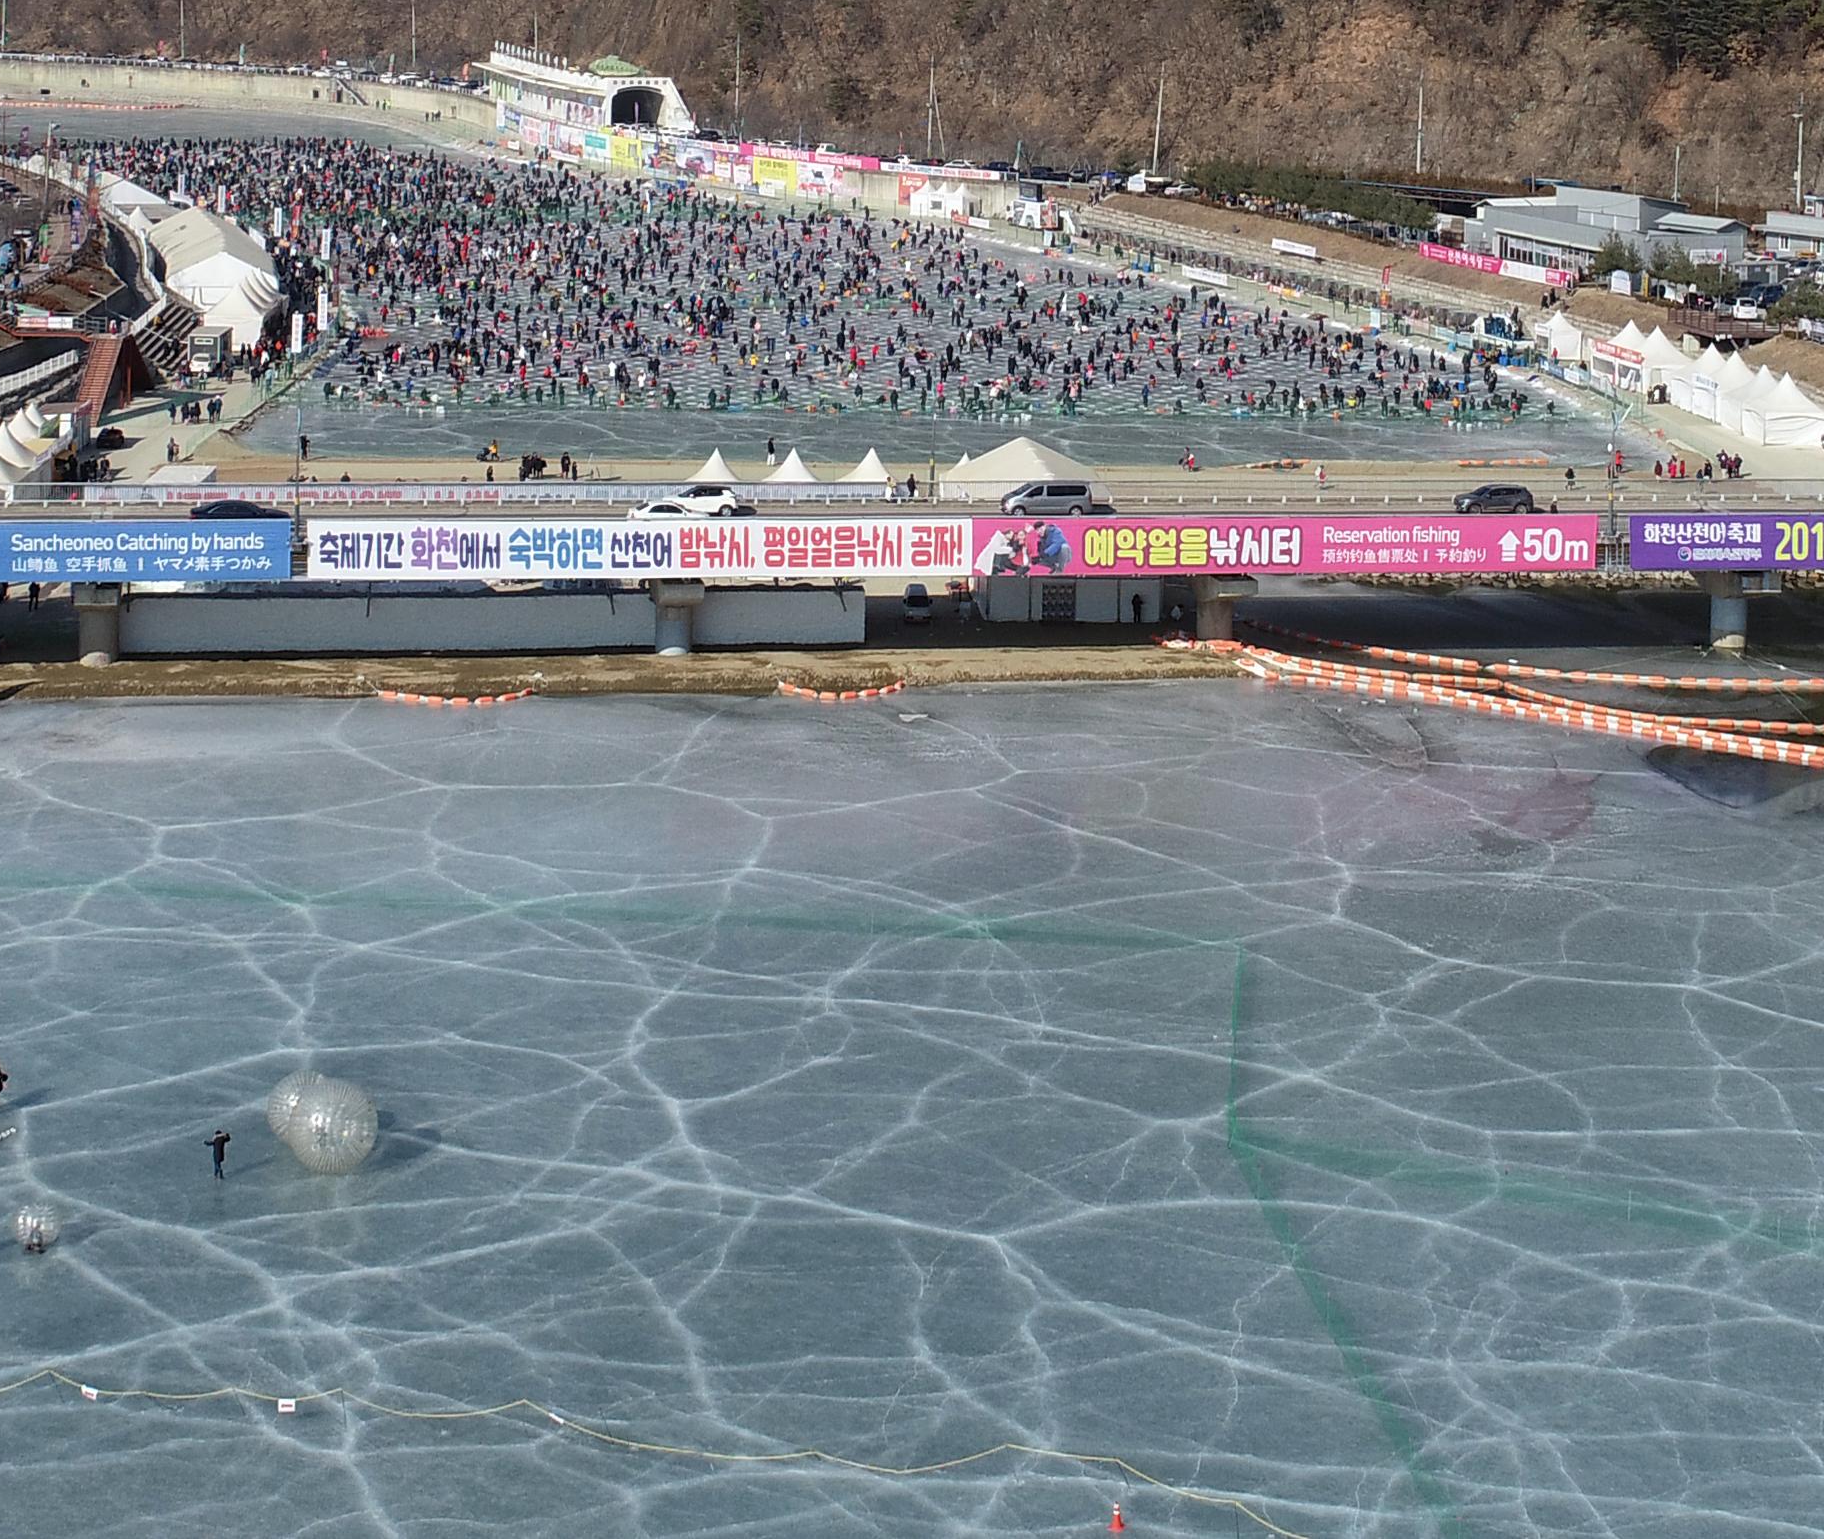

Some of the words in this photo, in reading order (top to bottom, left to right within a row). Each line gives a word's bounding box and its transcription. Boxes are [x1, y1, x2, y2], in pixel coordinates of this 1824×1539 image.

[10, 533, 114, 552] Sancheoneo
[116, 533, 188, 556] Catching
[191, 533, 211, 554] by
[213, 531, 265, 550] hands
[319, 531, 405, 569] 축제기간
[410, 526, 501, 570] 화천에서
[508, 527, 604, 570] 숙박하면
[610, 530, 672, 569] 산천어
[679, 526, 756, 569] 밤낚시,
[763, 525, 903, 568] 평일얼음낚시
[910, 524, 963, 567] 공짜!
[1084, 527, 1302, 566] 예약얼음낚시터
[1323, 526, 1410, 544] Reservation
[1411, 525, 1460, 547] fishing
[1523, 527, 1589, 562] 50m
[1643, 522, 1762, 545] 화천산천어축제
